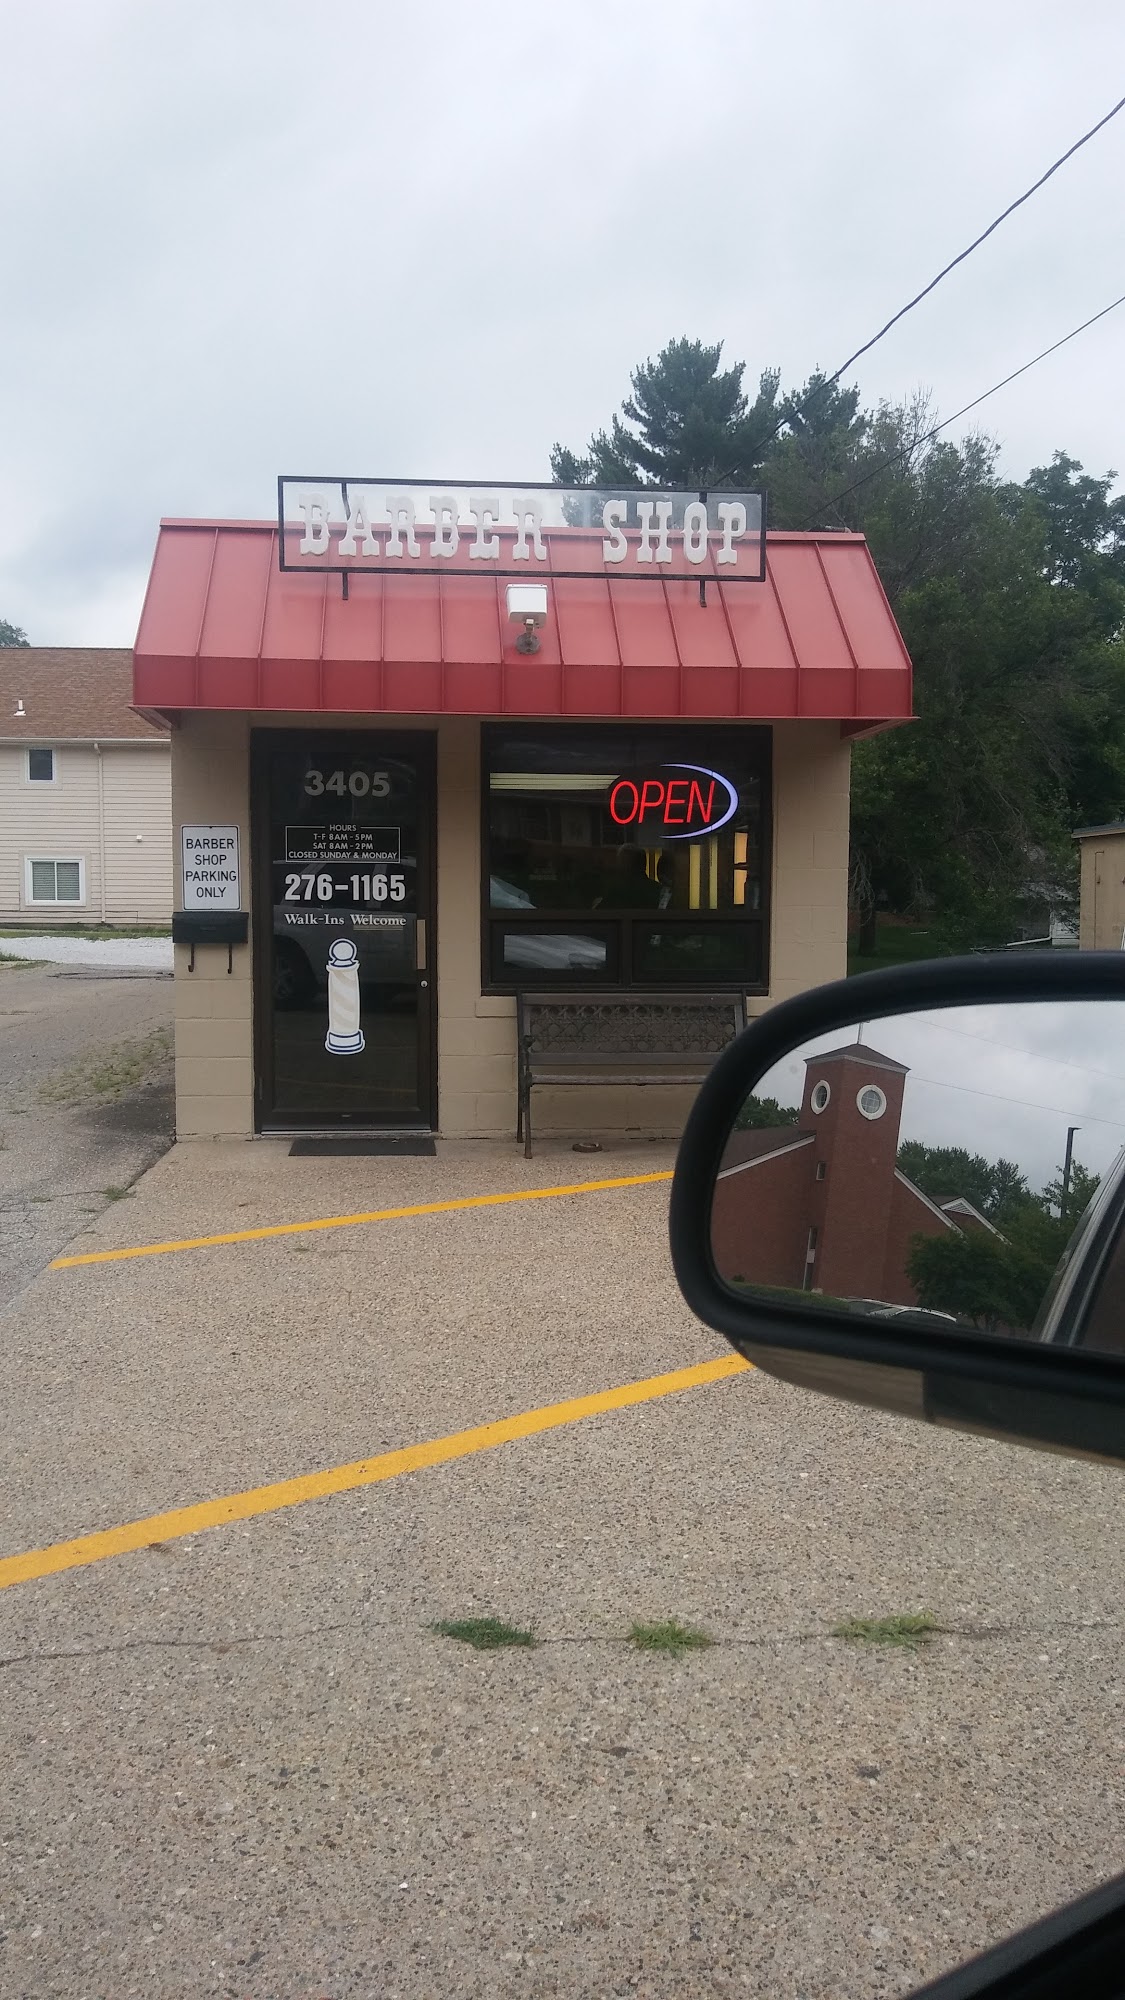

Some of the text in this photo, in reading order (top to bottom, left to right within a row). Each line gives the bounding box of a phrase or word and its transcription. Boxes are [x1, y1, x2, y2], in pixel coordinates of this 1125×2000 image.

[299, 493, 747, 565] BARBER SHOP
[304, 770, 391, 797] 3405
[610, 780, 716, 825] OPEN
[329, 824, 357, 832] HOURS
[186, 838, 235, 849] BARBER
[313, 842, 326, 850] SAT
[194, 854, 227, 866] SHOP
[288, 851, 318, 859] CLOSED
[320, 851, 352, 859] SUNDAY
[361, 852, 398, 860] MONDAY
[185, 870, 237, 882] PARKING
[196, 886, 226, 898] ONLY
[284, 873, 406, 901] 276-1165
[284, 913, 407, 926] Walk-Ins Welcome
